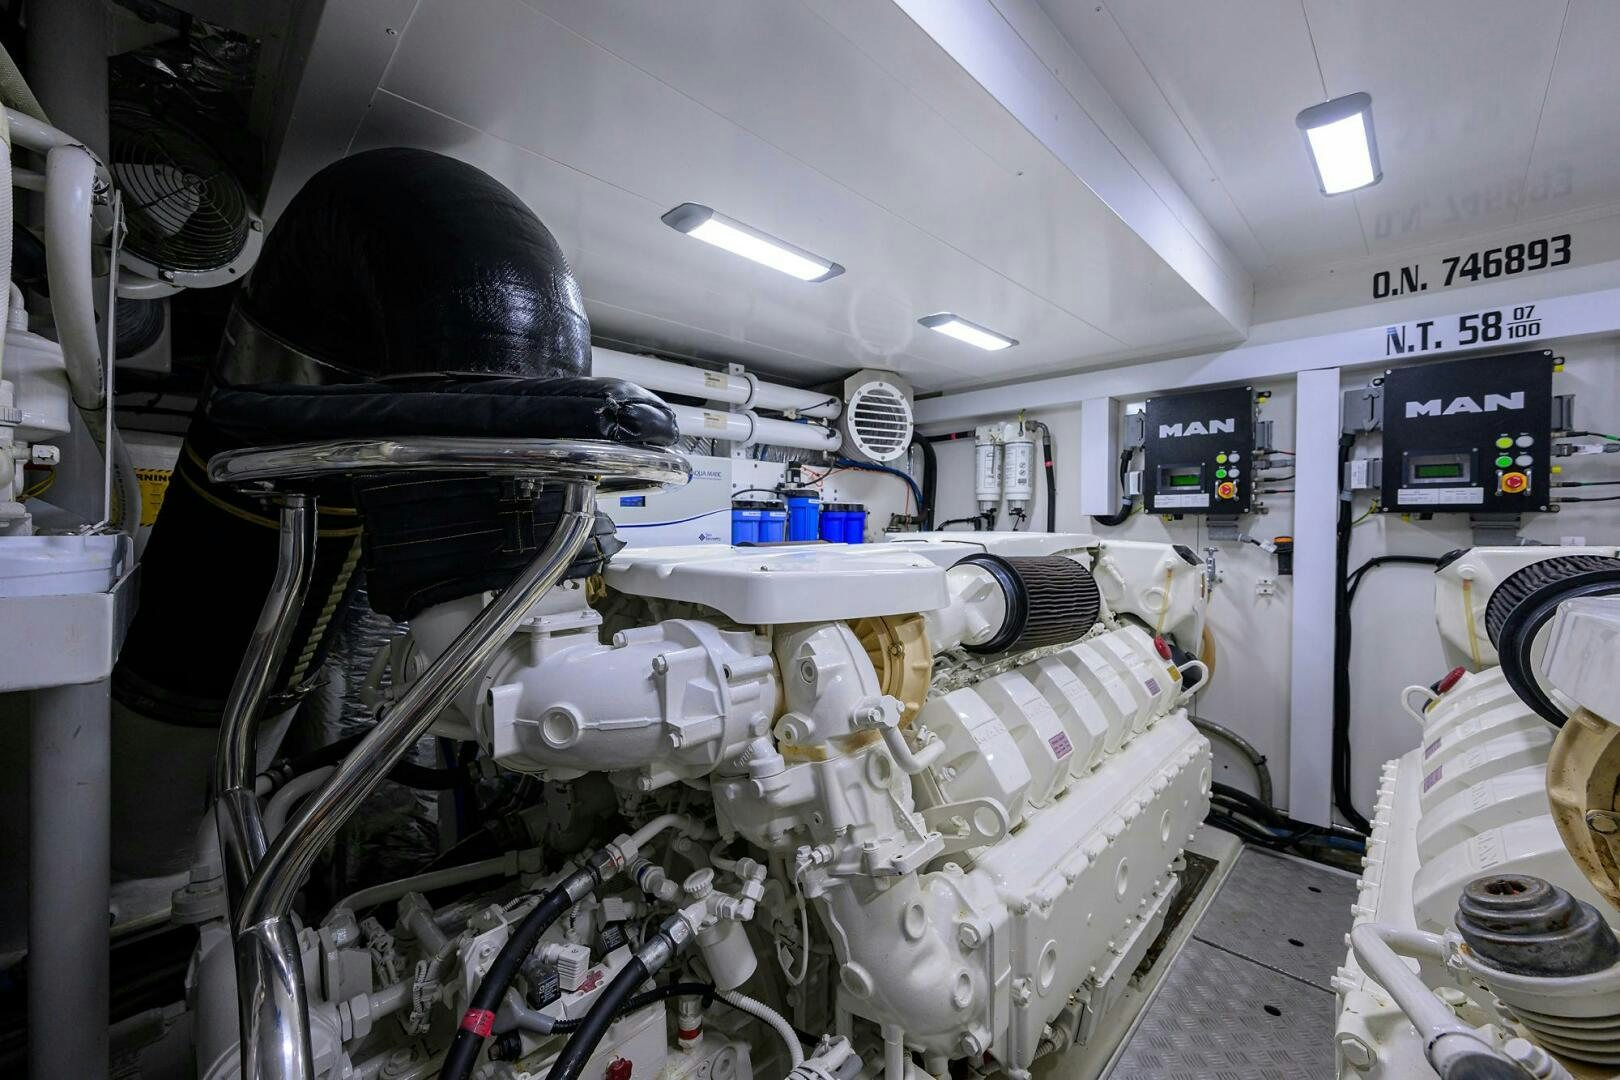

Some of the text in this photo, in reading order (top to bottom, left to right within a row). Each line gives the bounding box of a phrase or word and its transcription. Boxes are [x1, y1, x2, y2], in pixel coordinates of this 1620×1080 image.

[1372, 233, 1572, 299] O.N. 746893
[1512, 305, 1536, 321] 07
[1386, 310, 1503, 356] N.T. 58
[1507, 322, 1541, 339] 100
[1405, 391, 1526, 419] MAN
[1158, 418, 1236, 439] MAN
